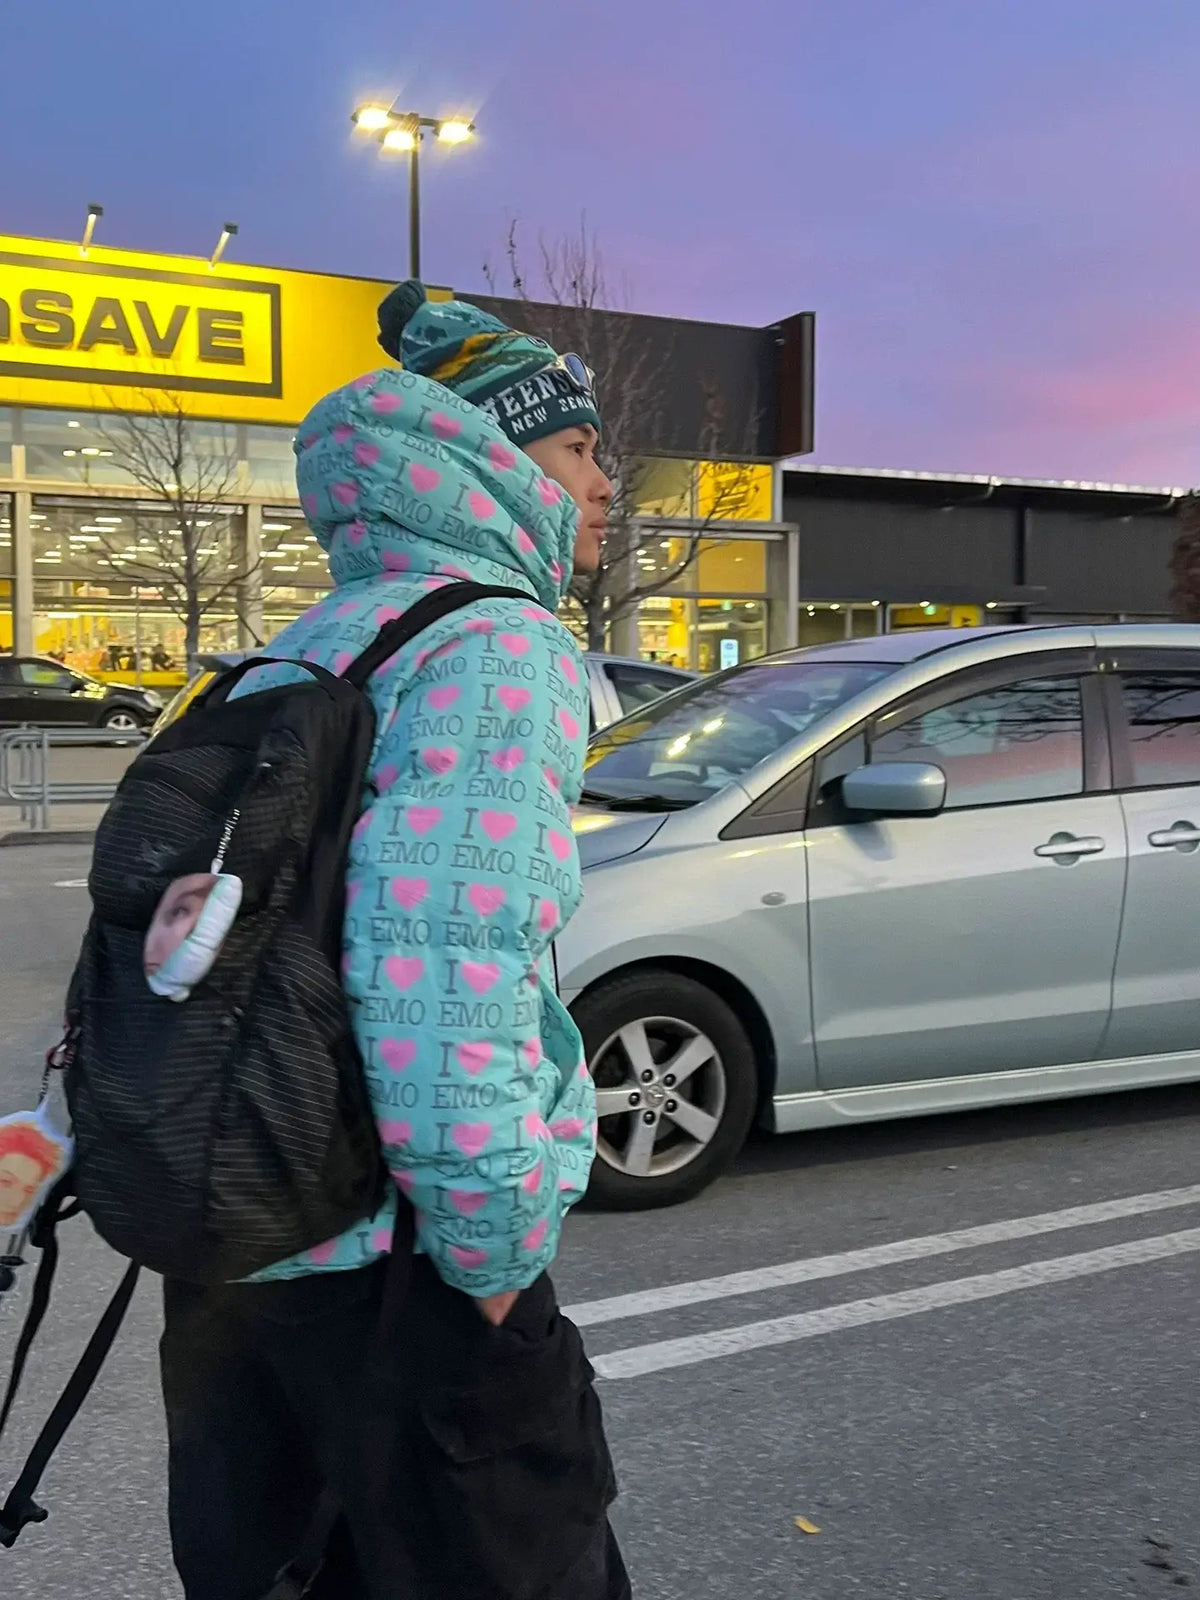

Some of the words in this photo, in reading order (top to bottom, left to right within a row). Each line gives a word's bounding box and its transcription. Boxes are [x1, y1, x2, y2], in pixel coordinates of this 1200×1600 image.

[423, 383, 475, 414] EMO
[412, 405, 432, 433] I
[391, 455, 411, 485] I
[379, 485, 432, 524] EMO
[451, 482, 470, 513] I
[338, 624, 378, 648] EM
[483, 632, 496, 653] I
[479, 656, 536, 680] EMO
[481, 684, 495, 711] I
[545, 670, 582, 716] EMO
[408, 714, 463, 738] EMO
[474, 716, 534, 739] EMO
[549, 698, 559, 728] I
[476, 750, 490, 774] I
[543, 725, 577, 773] EMO
[463, 778, 526, 802] EMO
[387, 805, 404, 836] I
[461, 807, 479, 839] I
[535, 822, 547, 854] I
[378, 841, 440, 865] EMO
[450, 843, 515, 874] EMO
[525, 856, 572, 897] EMO
[375, 876, 389, 911] I
[449, 880, 466, 915] I
[370, 916, 431, 945] EMO
[442, 920, 505, 950] EMO
[367, 954, 383, 990] I
[445, 959, 459, 995] I
[363, 995, 426, 1026] EMO
[437, 1000, 503, 1029] EMO
[365, 1036, 378, 1072] I
[438, 1041, 454, 1078] I
[513, 1039, 525, 1074] I
[430, 1083, 497, 1110] EMO
[434, 1122, 450, 1156] I
[513, 1115, 524, 1150] I
